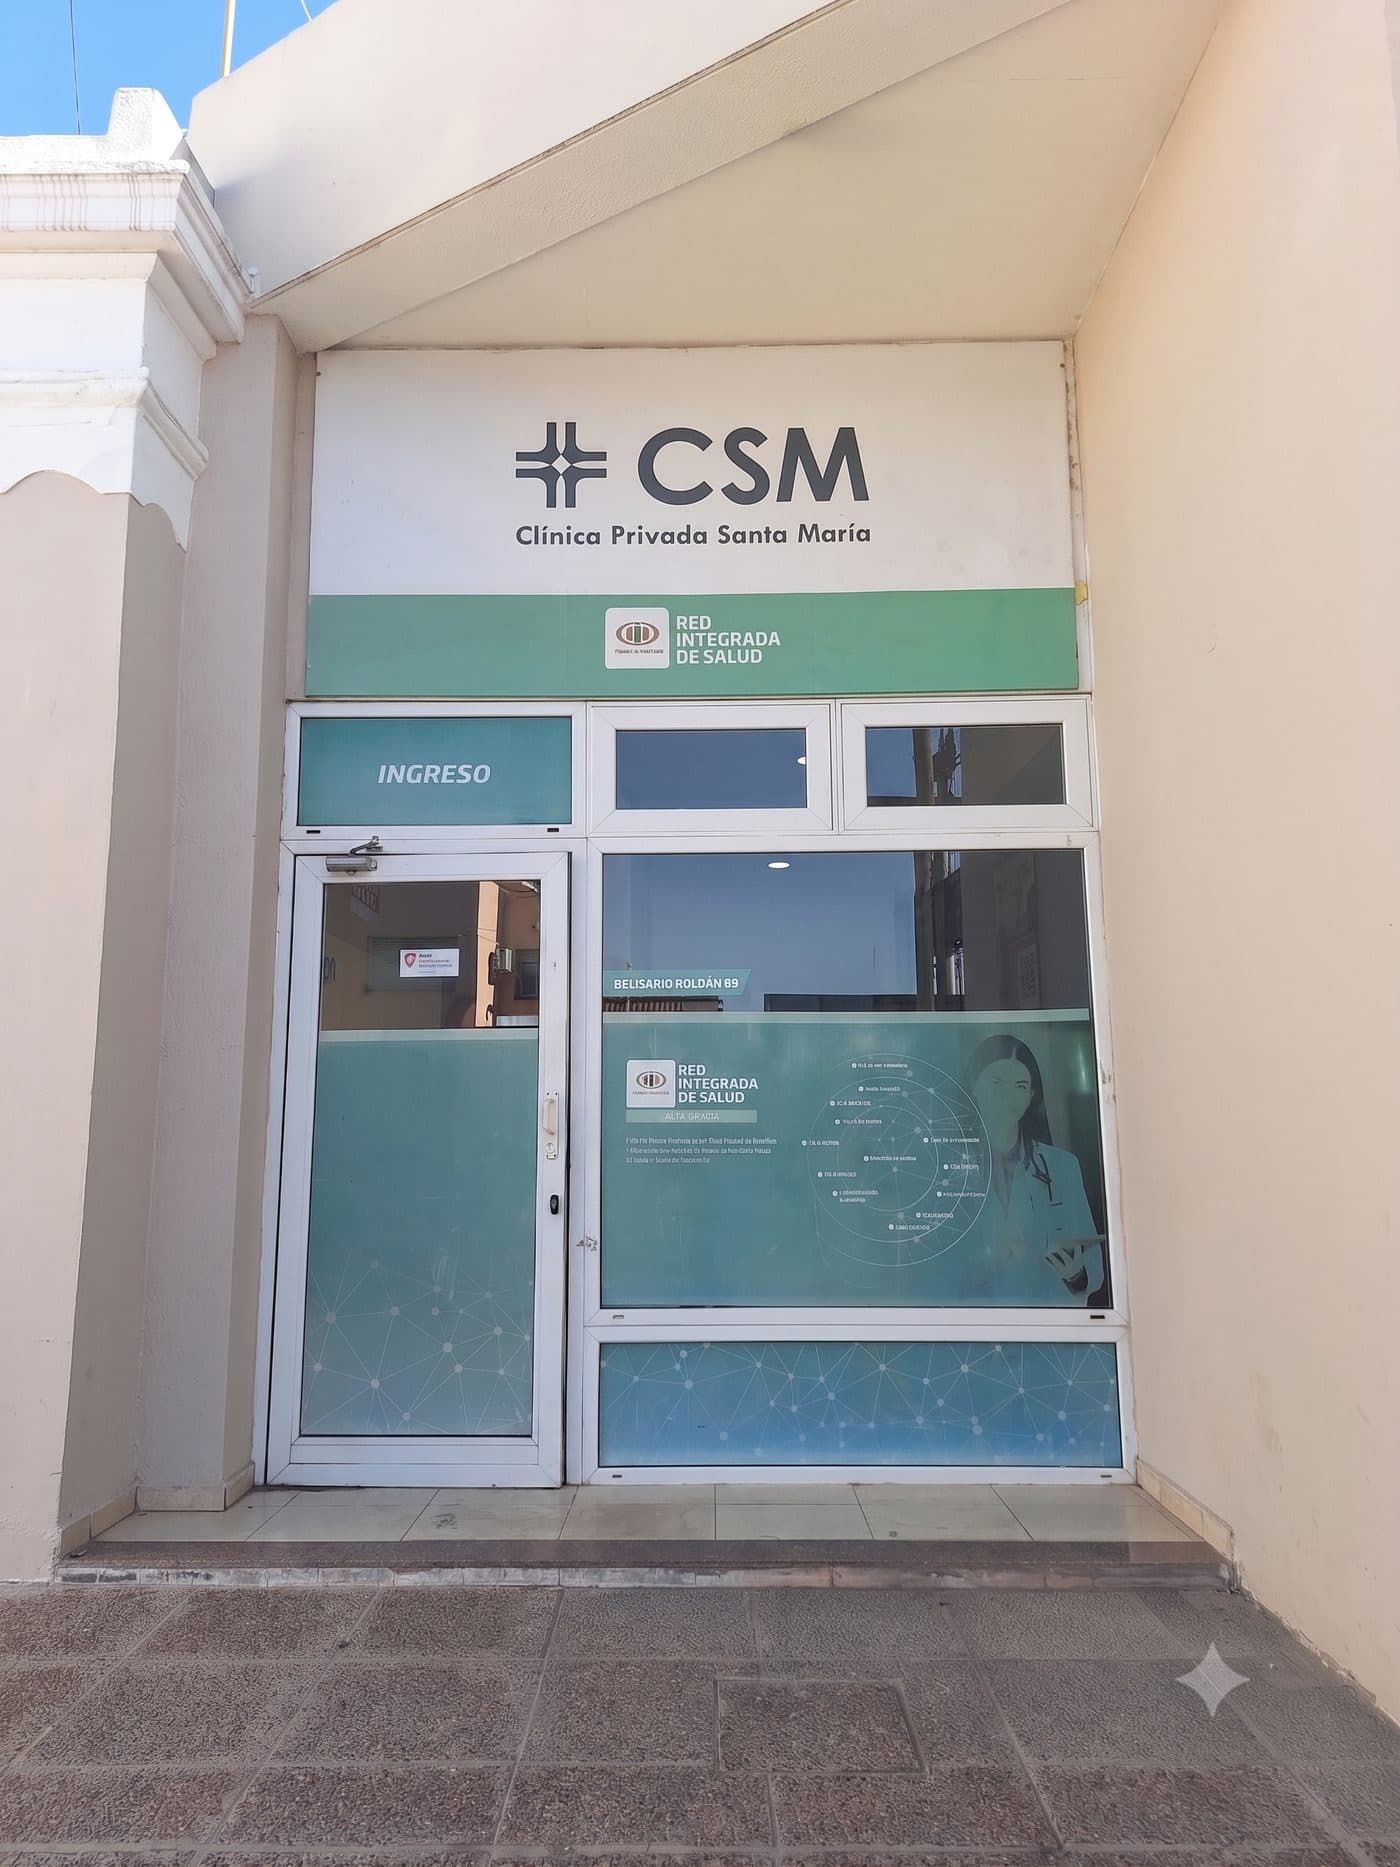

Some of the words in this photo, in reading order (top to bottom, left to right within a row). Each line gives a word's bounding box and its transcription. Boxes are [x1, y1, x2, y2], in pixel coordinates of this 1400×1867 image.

[638, 427, 870, 505] CSM
[515, 525, 601, 545] Clínica
[611, 524, 708, 545] Privada
[718, 524, 787, 544] Santa
[798, 523, 871, 543] María
[676, 615, 712, 630] RED
[676, 631, 781, 647] INTEGRADA
[676, 649, 700, 664] DE
[703, 649, 763, 664] SALUD
[377, 764, 491, 784] INGRESO
[614, 978, 673, 989] BELISARIO
[675, 975, 722, 989] ROLDÁN
[678, 1064, 706, 1076] RED
[678, 1078, 759, 1089] INTEGRADA
[678, 1092, 697, 1103] DE
[700, 1091, 745, 1103] SALUD
[665, 1112, 686, 1120] ALTA
[688, 1112, 719, 1120] GRACIA
